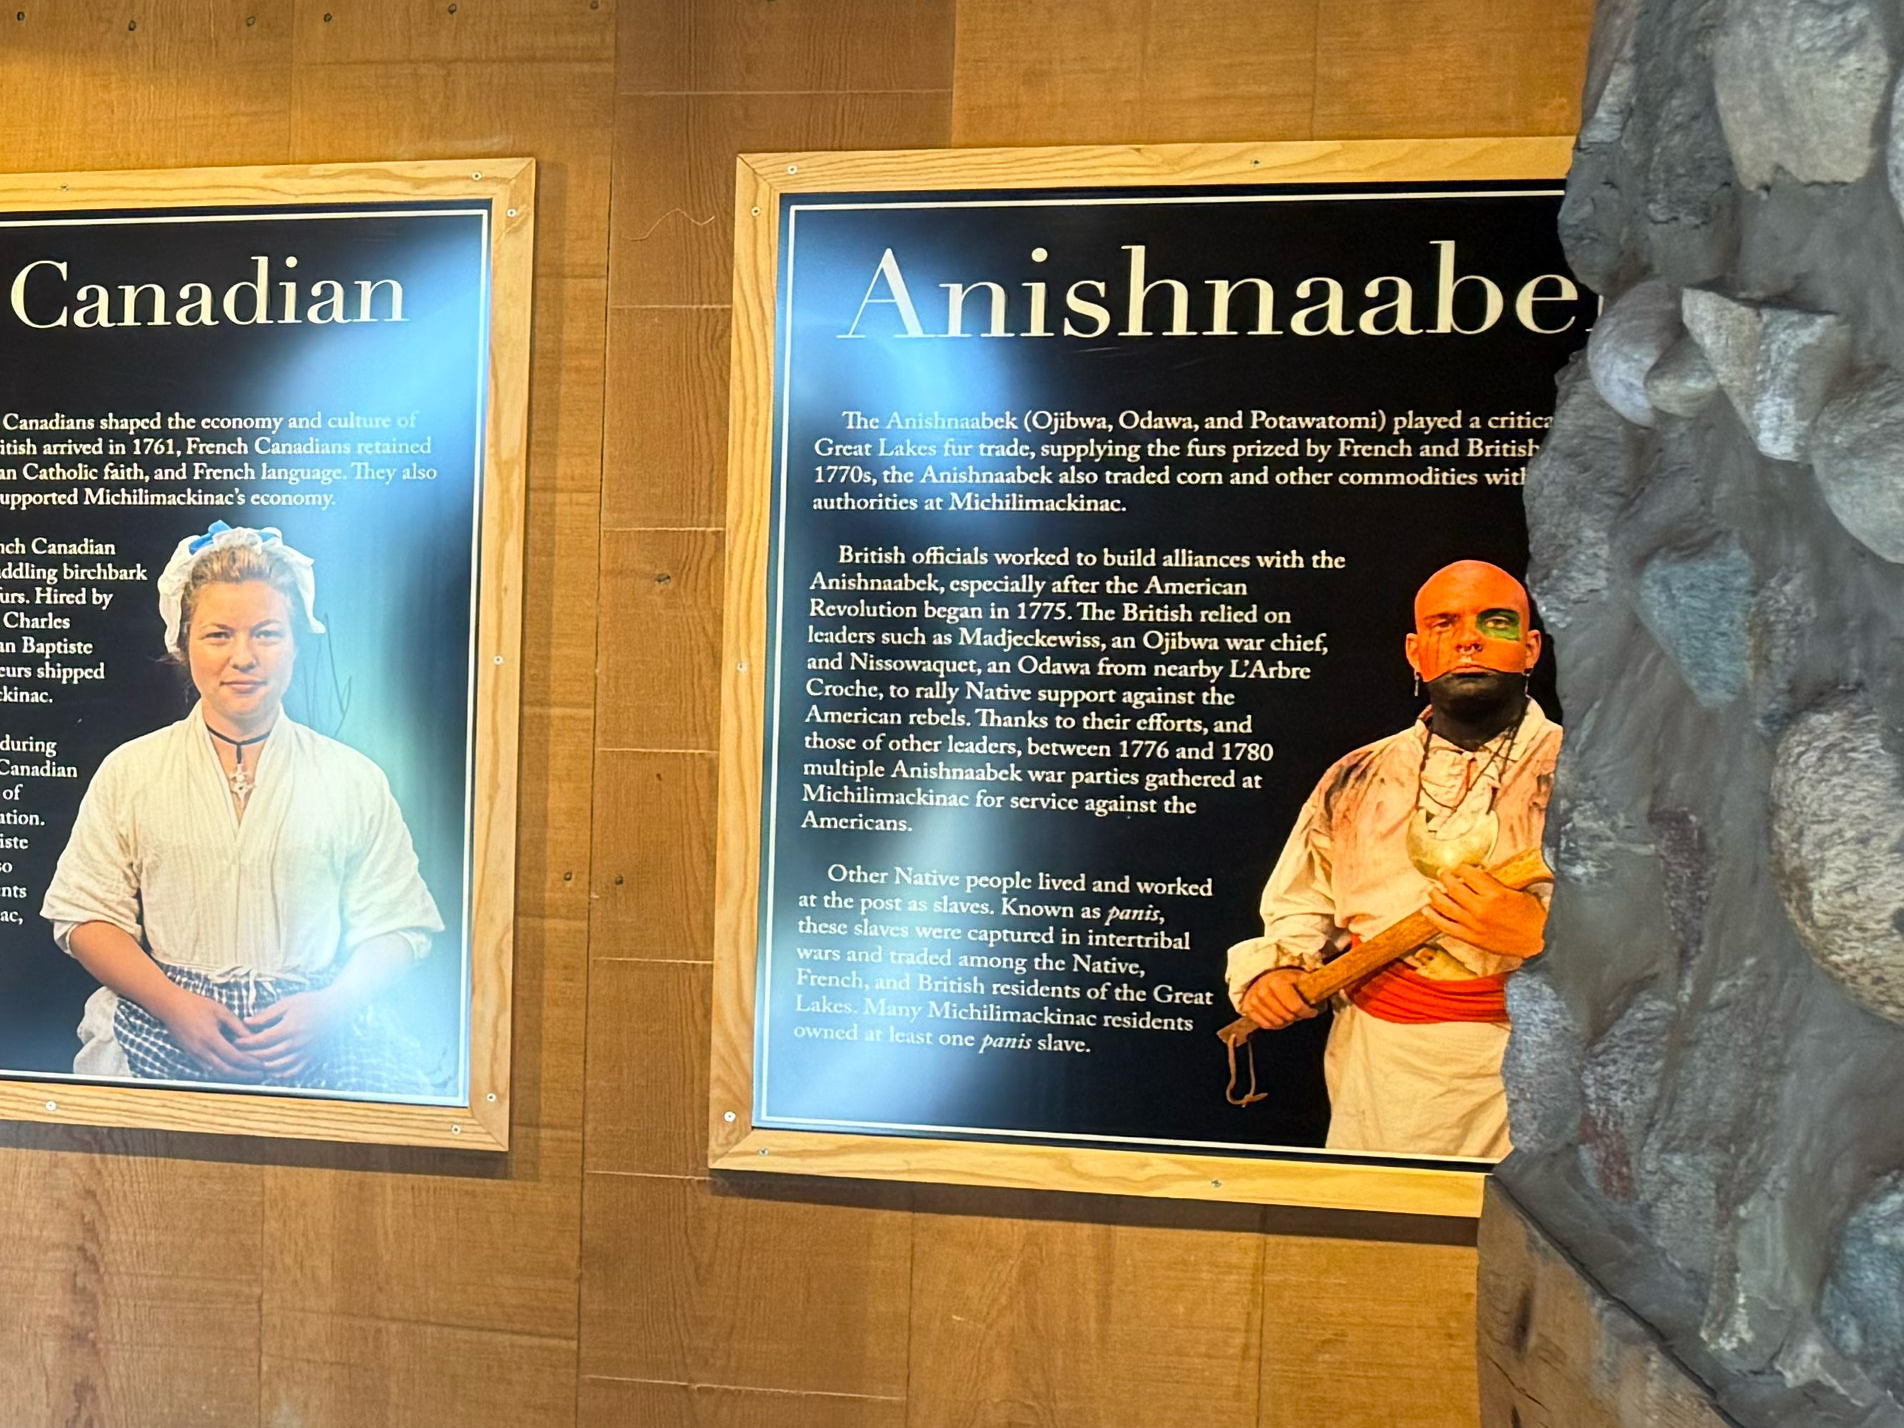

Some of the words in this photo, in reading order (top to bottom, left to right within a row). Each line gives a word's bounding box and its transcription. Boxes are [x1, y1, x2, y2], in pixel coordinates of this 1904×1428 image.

[10, 255, 409, 329] Canadian
[836, 239, 1604, 336] Anishnaabe
[1, 412, 96, 432] Canadians
[99, 411, 163, 437] shaped
[166, 412, 198, 431] the
[201, 416, 283, 435] economy
[288, 413, 322, 430] and
[327, 412, 392, 430] culture
[396, 411, 420, 430] of
[842, 410, 879, 430] The
[886, 410, 1018, 430] Anishnaabek
[1024, 410, 1114, 435] (Ojibwa,
[1118, 410, 1201, 434] Odawa,
[1204, 409, 1245, 431] and
[1249, 409, 1387, 433] Potawatomi)
[1393, 410, 1463, 435] played
[1469, 416, 1482, 429] a
[805, 677, 884, 701] Croche,
[889, 684, 910, 699] to
[915, 680, 960, 710] rally
[965, 681, 1032, 701] Native
[1037, 689, 1117, 709] support
[1121, 686, 1196, 710] against
[1201, 685, 1235, 706] the
[793, 1024, 858, 1041] owned
[864, 1027, 882, 1042] at
[889, 1026, 933, 1045] least
[939, 1032, 975, 1047] one
[978, 1033, 1032, 1054] panis
[1037, 1038, 1091, 1054] slave.
